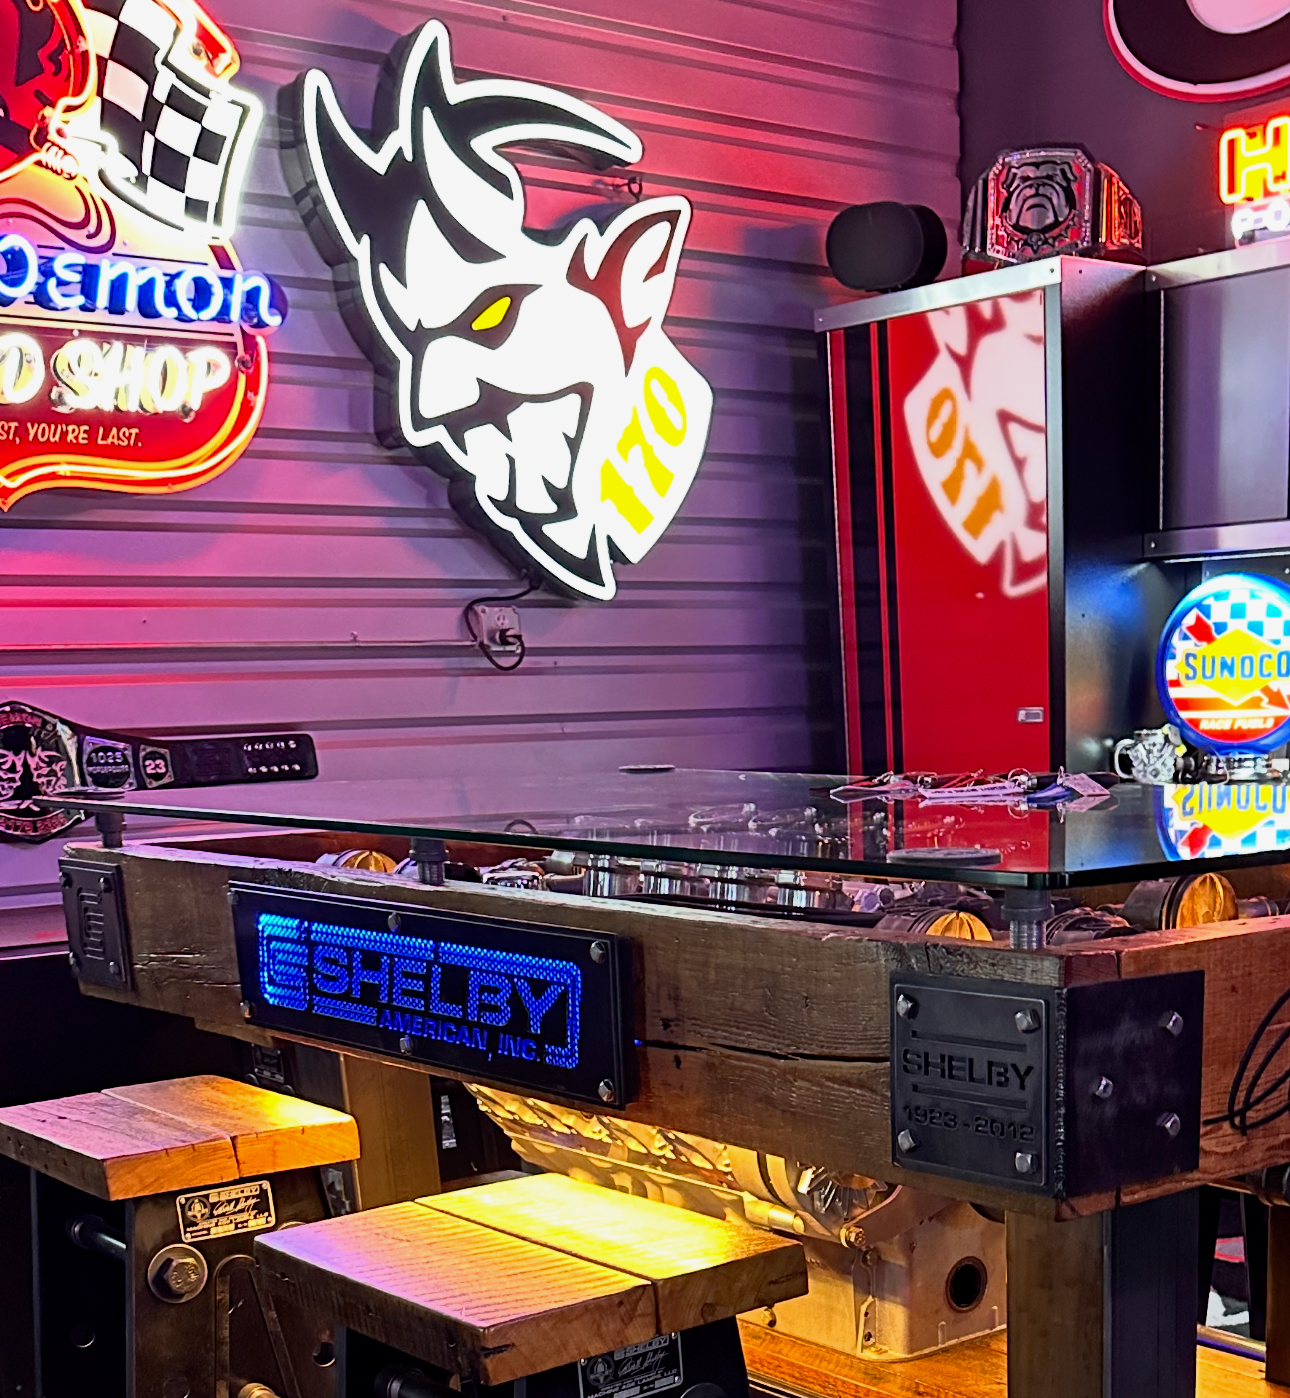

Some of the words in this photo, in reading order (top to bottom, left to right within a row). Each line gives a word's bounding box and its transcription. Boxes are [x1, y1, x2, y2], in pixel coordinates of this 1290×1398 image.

[51, 338, 232, 414] SHOP
[27, 422, 90, 443] YOU'RE
[97, 425, 143, 447] LAST.
[600, 366, 687, 535] 170
[1184, 650, 1290, 682] SUNOCO
[1199, 719, 1231, 730] RACE
[1234, 717, 1275, 729] FUELS
[90, 751, 124, 764] 1025
[144, 759, 167, 774] 23
[313, 943, 566, 1034] SHELBY
[497, 1033, 541, 1063] INC.
[902, 1048, 1034, 1091] SHELBY
